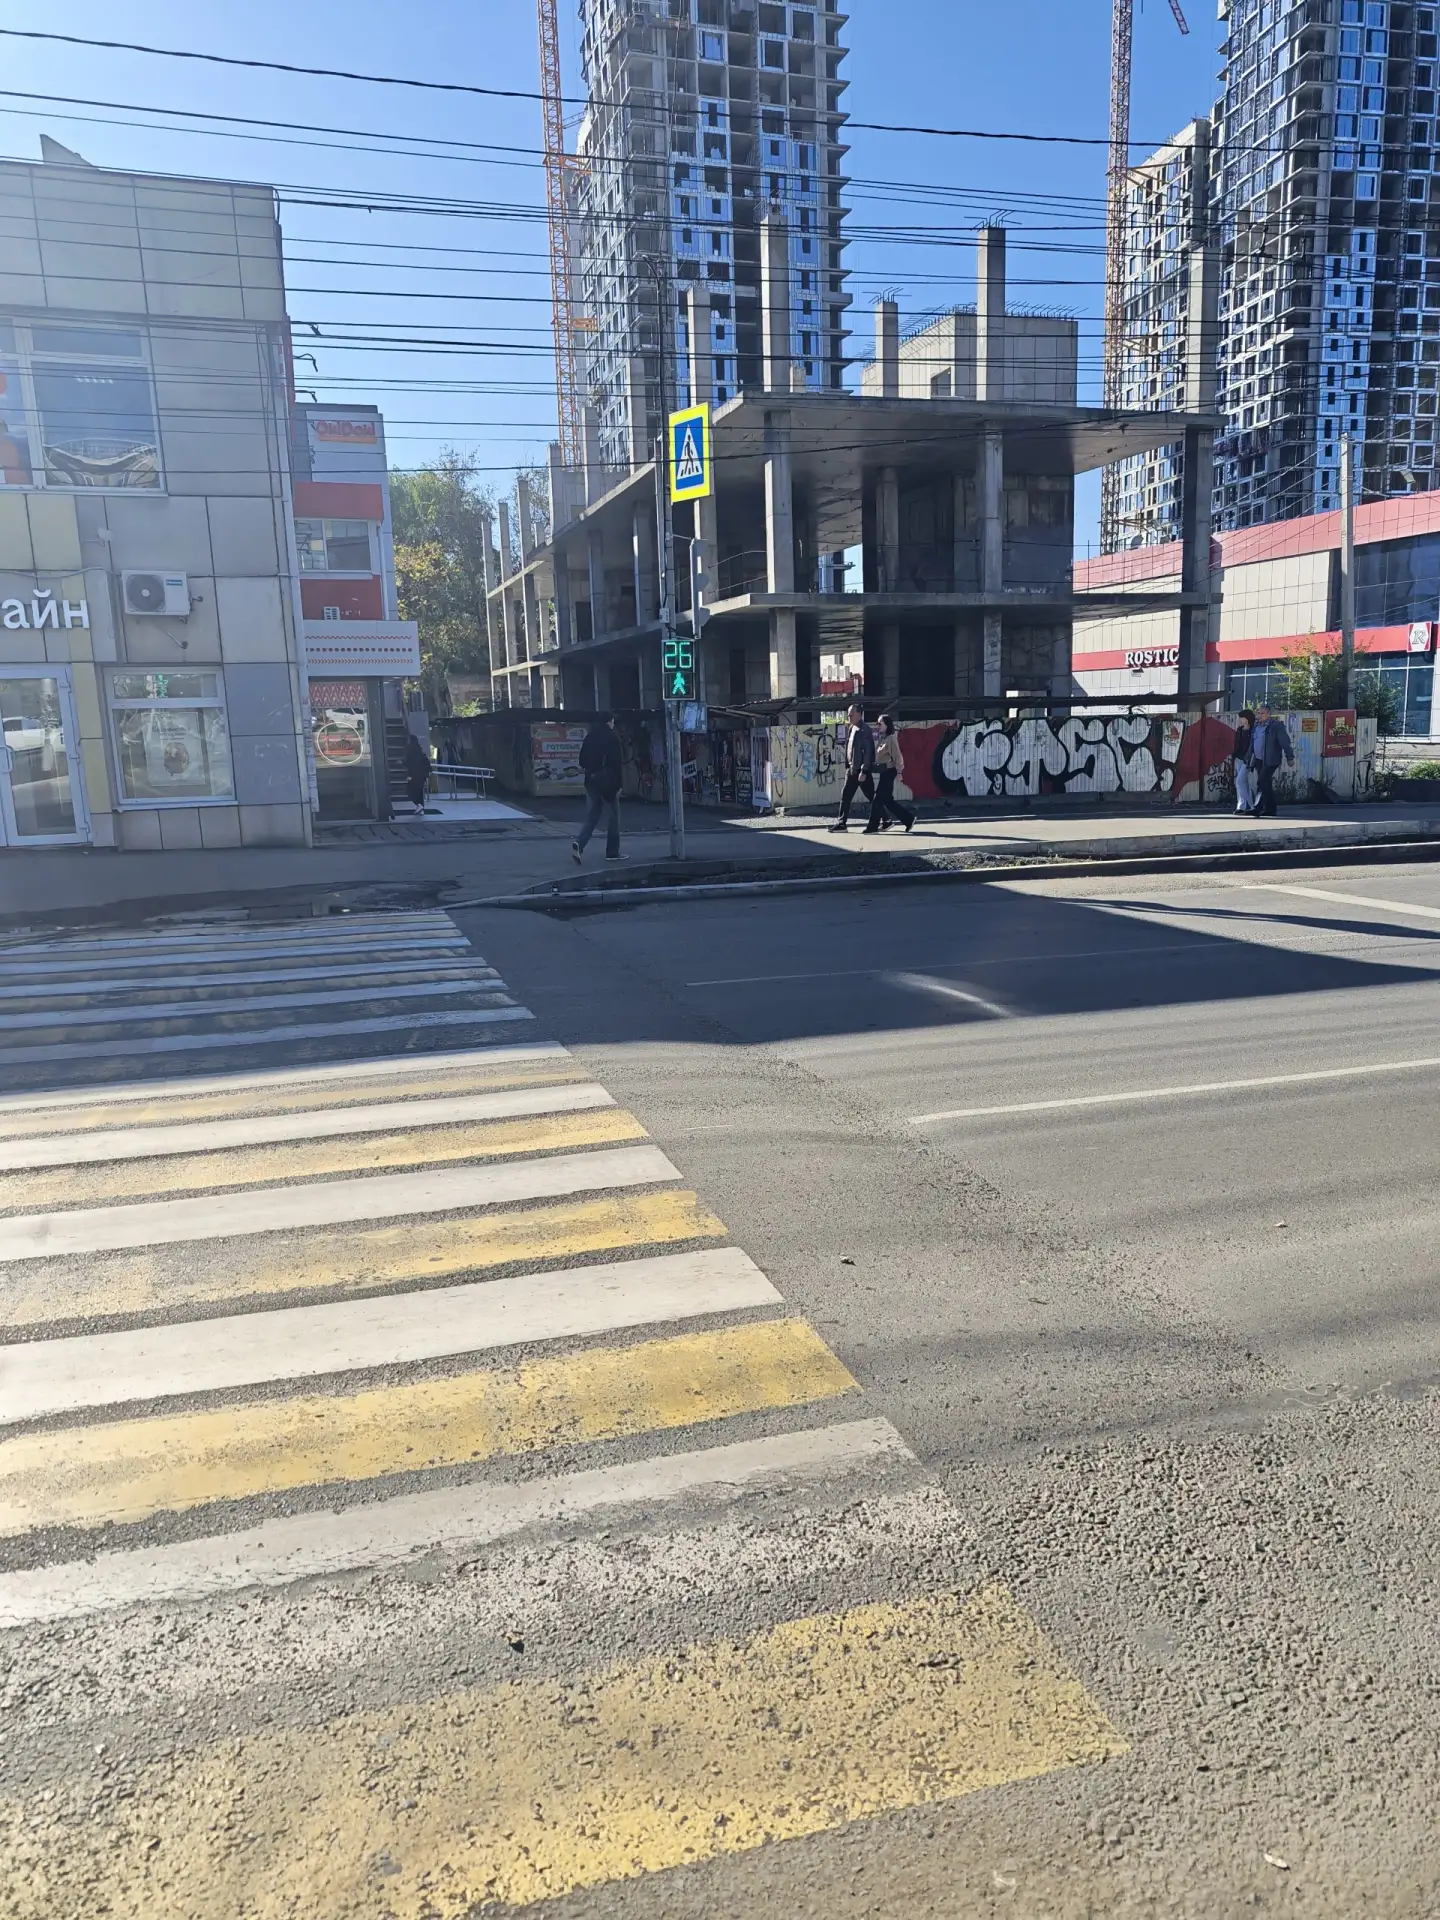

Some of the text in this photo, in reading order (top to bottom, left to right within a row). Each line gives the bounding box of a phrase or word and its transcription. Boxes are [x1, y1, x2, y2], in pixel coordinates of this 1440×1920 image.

[1, 589, 90, 629] айн
[664, 641, 692, 668] 26
[1124, 648, 1179, 665] ROSTIC
